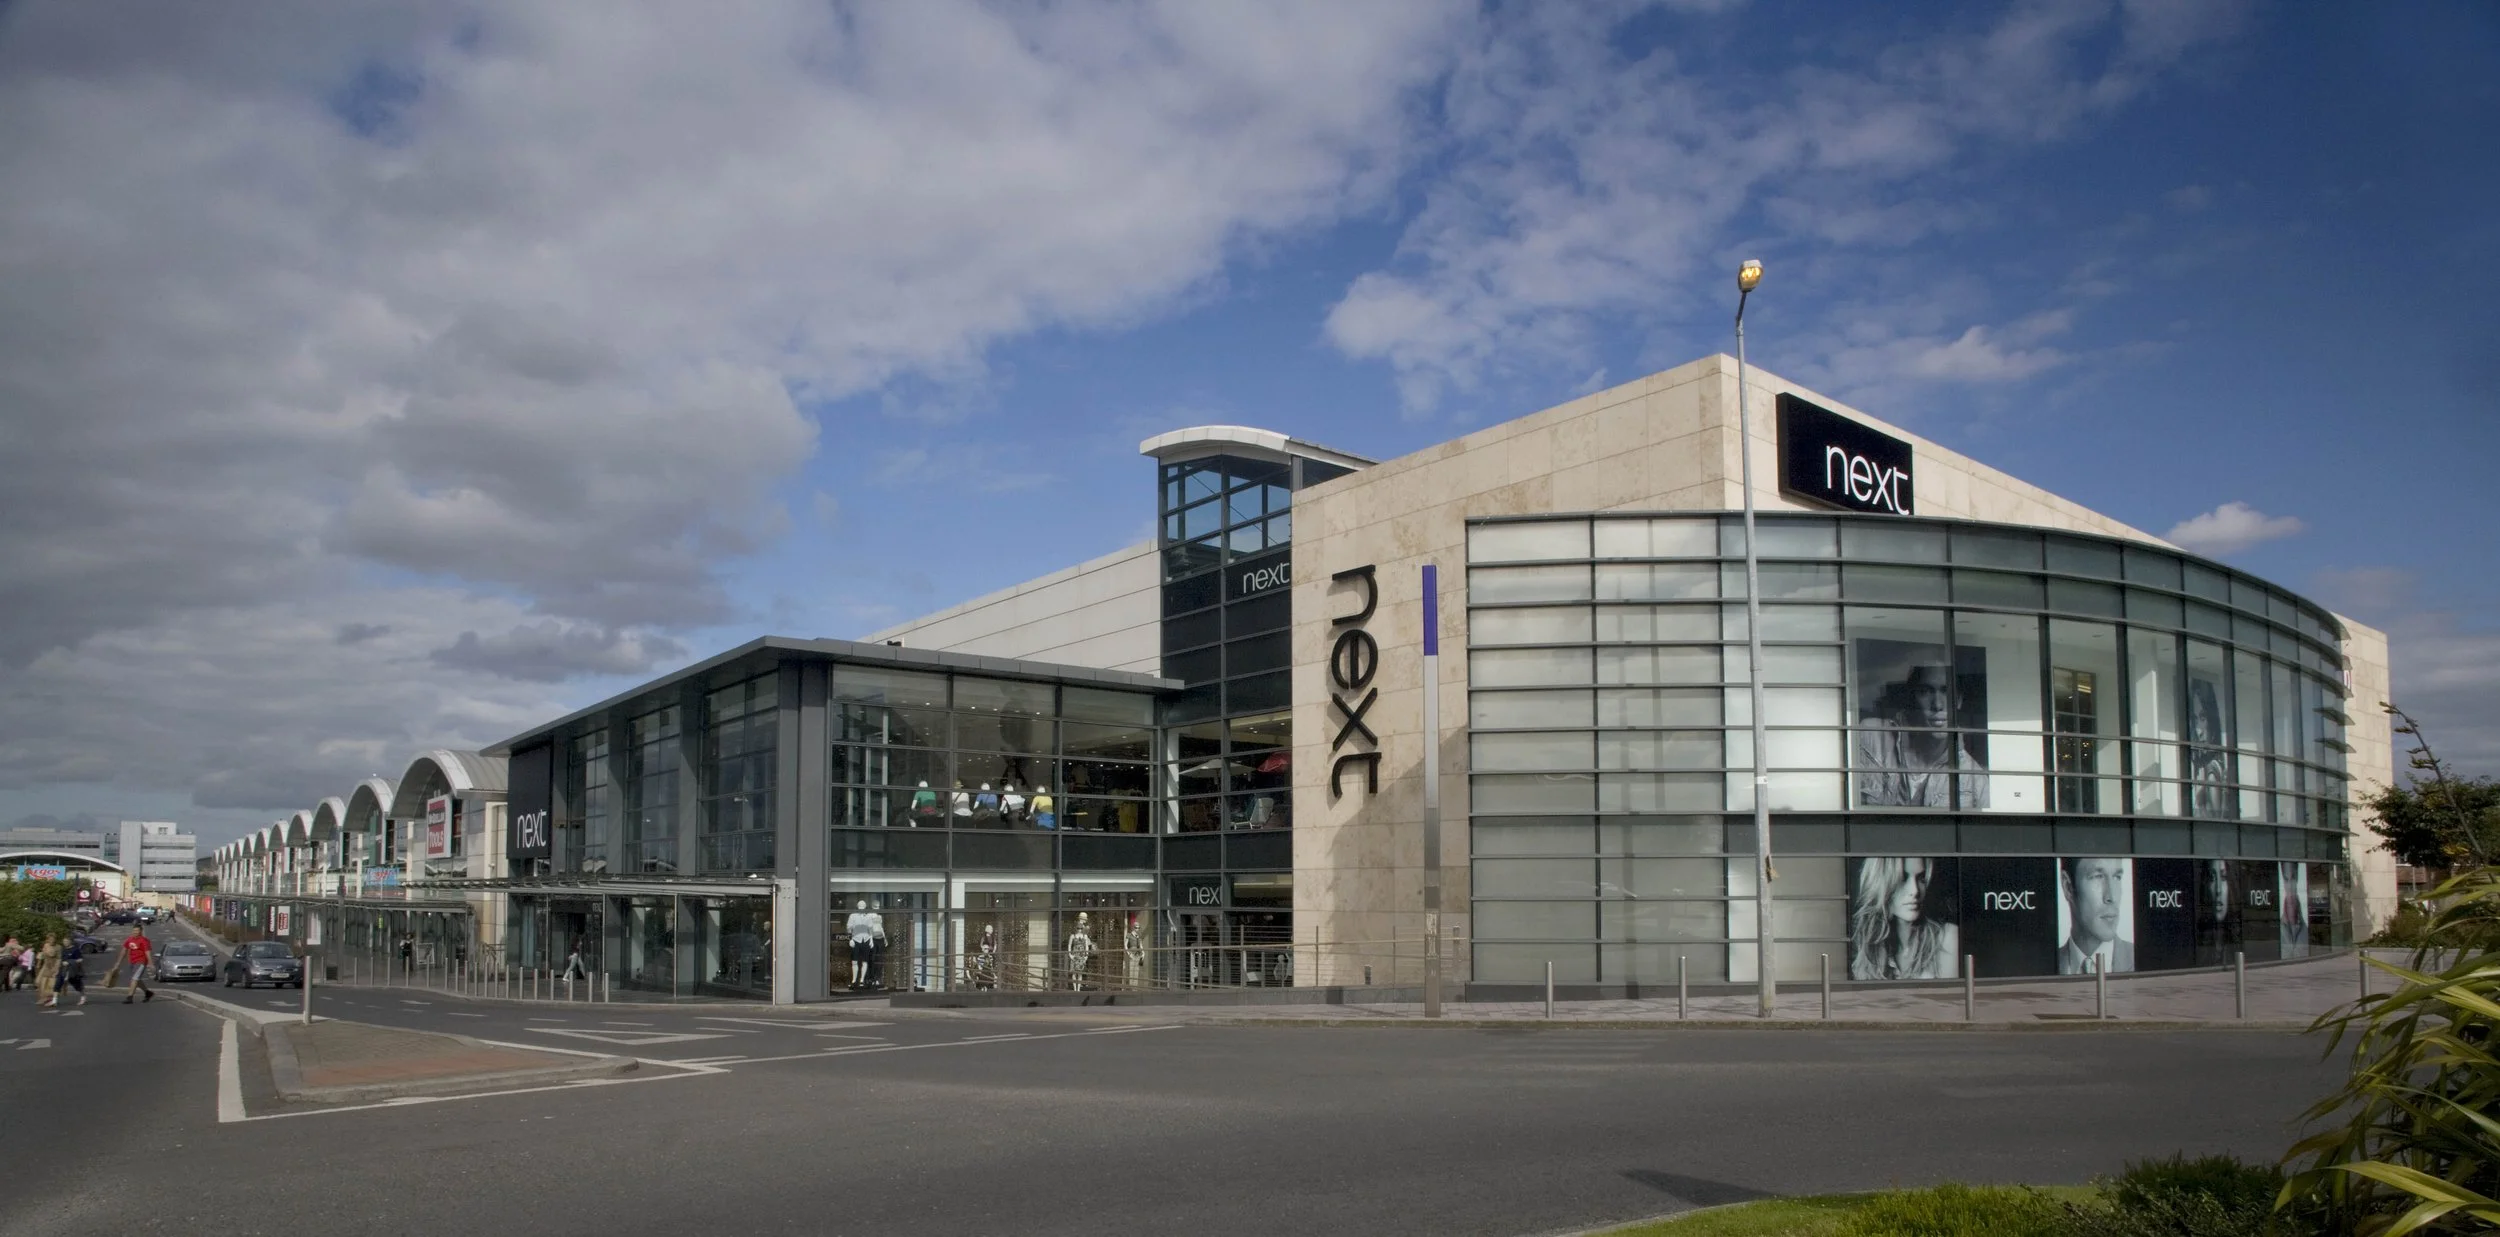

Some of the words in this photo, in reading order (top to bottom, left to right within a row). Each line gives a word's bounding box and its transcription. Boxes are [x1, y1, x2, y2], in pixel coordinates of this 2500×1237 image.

[1825, 444, 1911, 516] next
[1242, 559, 1290, 595] next
[1331, 563, 1383, 800] next
[429, 831, 444, 848] TOOLS
[516, 808, 548, 849] next
[25, 867, 61, 877] Argos
[1983, 889, 2037, 911] next
[2148, 888, 2183, 908] next
[2250, 889, 2271, 906] next
